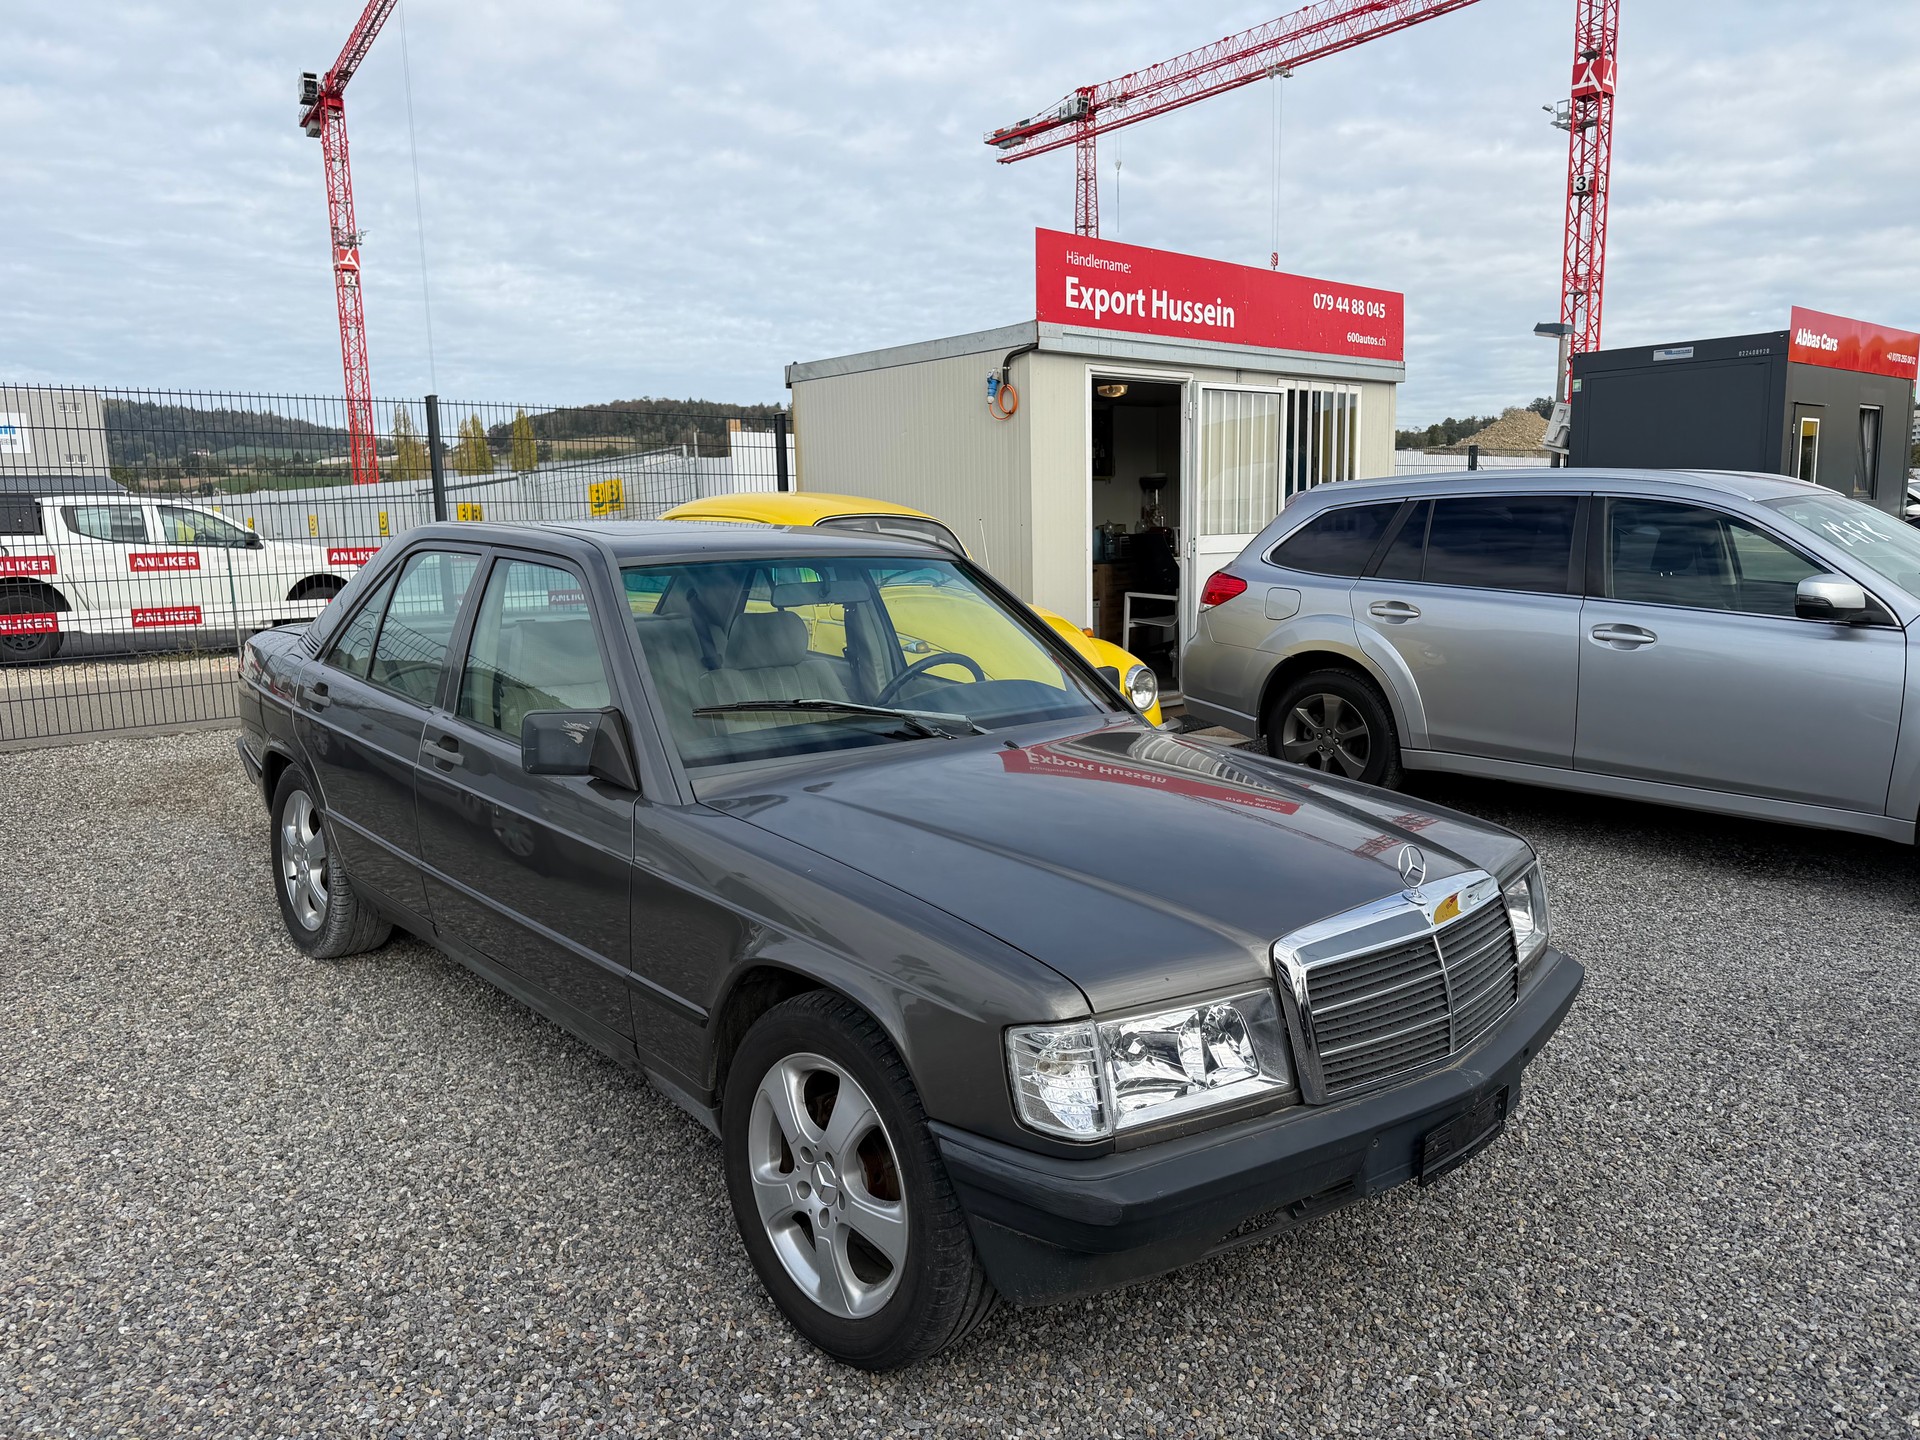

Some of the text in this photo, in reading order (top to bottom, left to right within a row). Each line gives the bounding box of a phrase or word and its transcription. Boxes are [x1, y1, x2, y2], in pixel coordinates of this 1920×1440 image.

[1575, 176, 1587, 191] 3
[1066, 250, 1132, 274] Händlername:
[347, 275, 353, 285] 2
[1065, 275, 1235, 329] Export Hussein
[1313, 292, 1386, 319] 079 44 88 045
[1346, 331, 1387, 347] 600autos.ch
[1794, 328, 1839, 352] Abbas Cars
[134, 556, 197, 568] ANLIKER
[135, 610, 198, 623] ANLIKER
